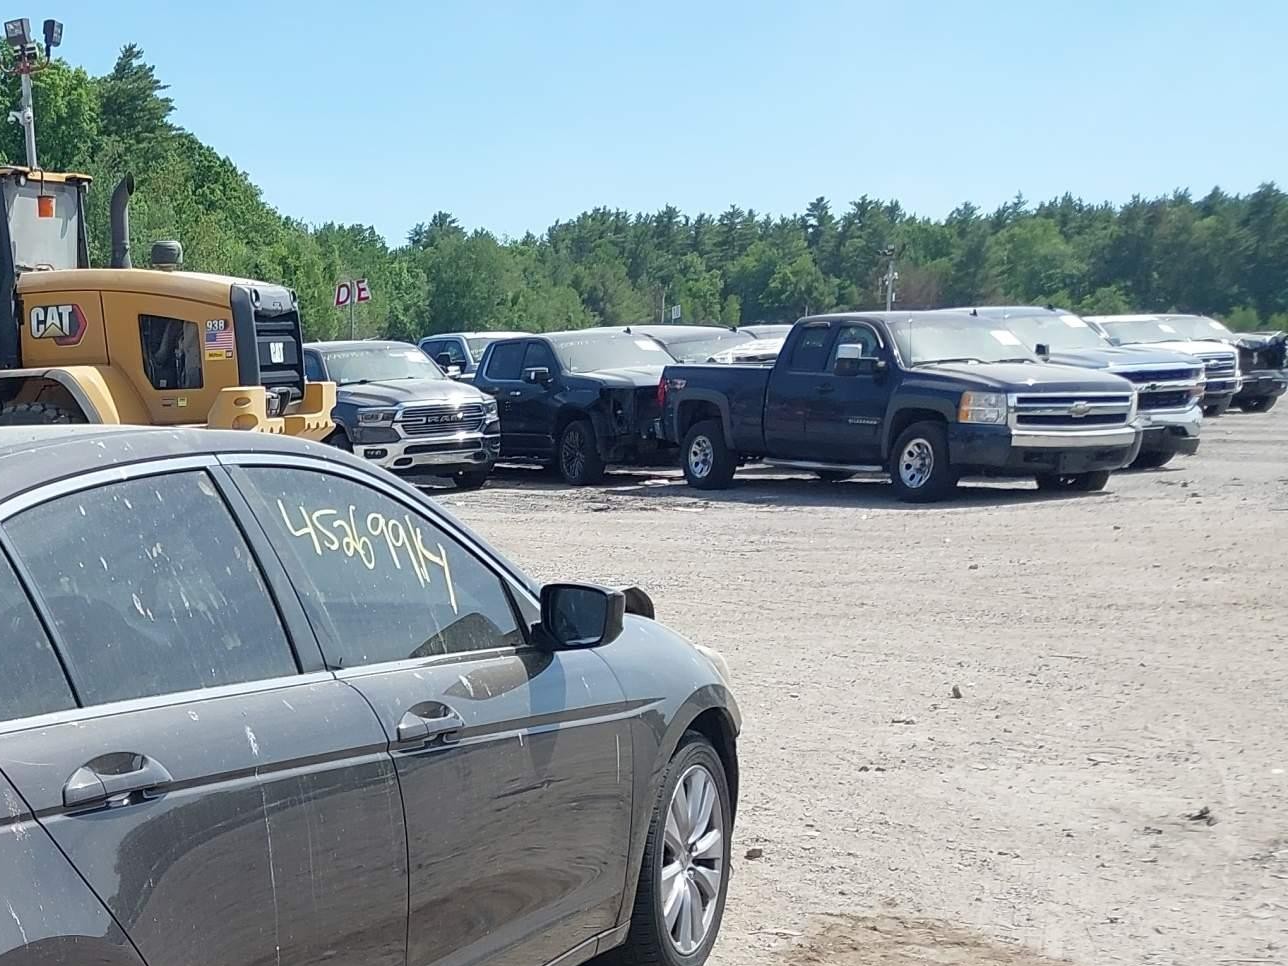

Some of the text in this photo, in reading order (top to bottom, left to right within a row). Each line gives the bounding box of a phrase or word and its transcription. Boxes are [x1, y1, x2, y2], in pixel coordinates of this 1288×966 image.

[336, 279, 370, 305] D E
[30, 305, 73, 338] CAT
